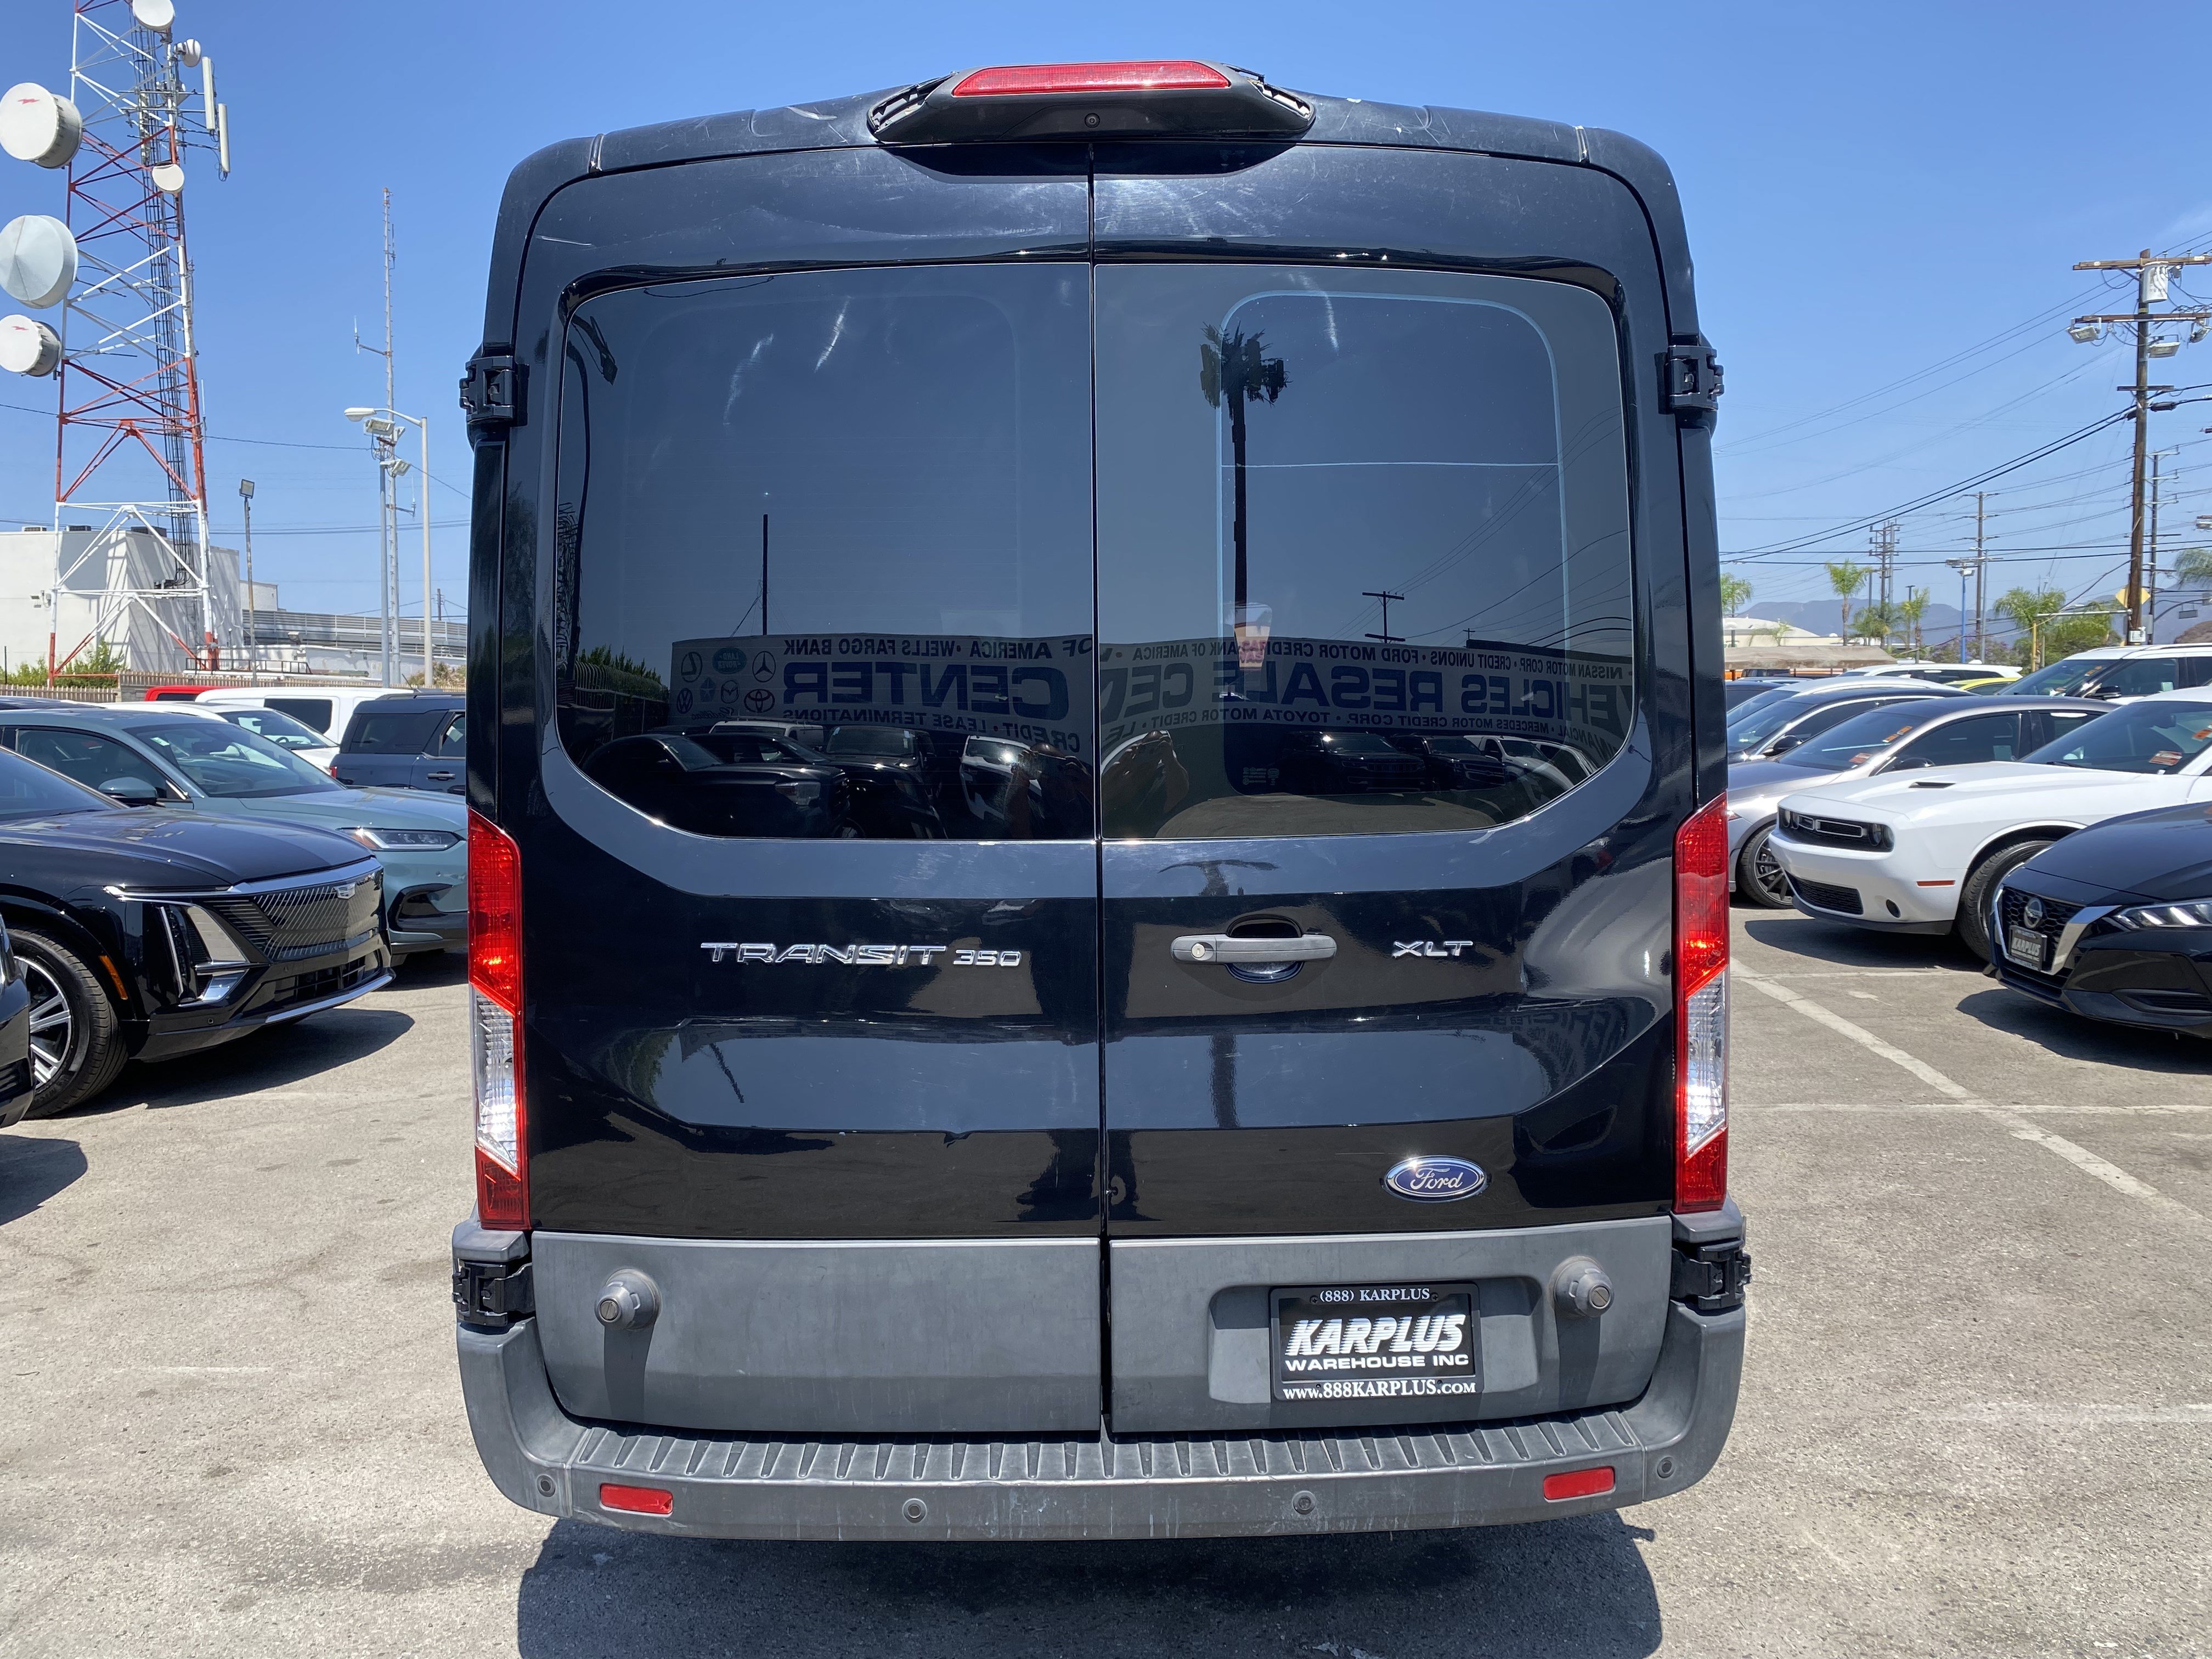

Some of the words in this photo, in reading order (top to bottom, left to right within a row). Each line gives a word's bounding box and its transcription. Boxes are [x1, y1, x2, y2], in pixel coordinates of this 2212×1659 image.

[701, 943, 947, 966] TRANSIT
[953, 949, 1022, 966] 350
[1392, 940, 1474, 958] XLT
[1410, 1167, 1464, 1190] Ford
[1319, 1291, 1355, 1302] (888)
[1359, 1288, 1430, 1301] KARPLUS
[1285, 1314, 1466, 1356] KARPLUS
[1285, 1356, 1426, 1372] WAREHOUSE
[1432, 1354, 1469, 1366] INC
